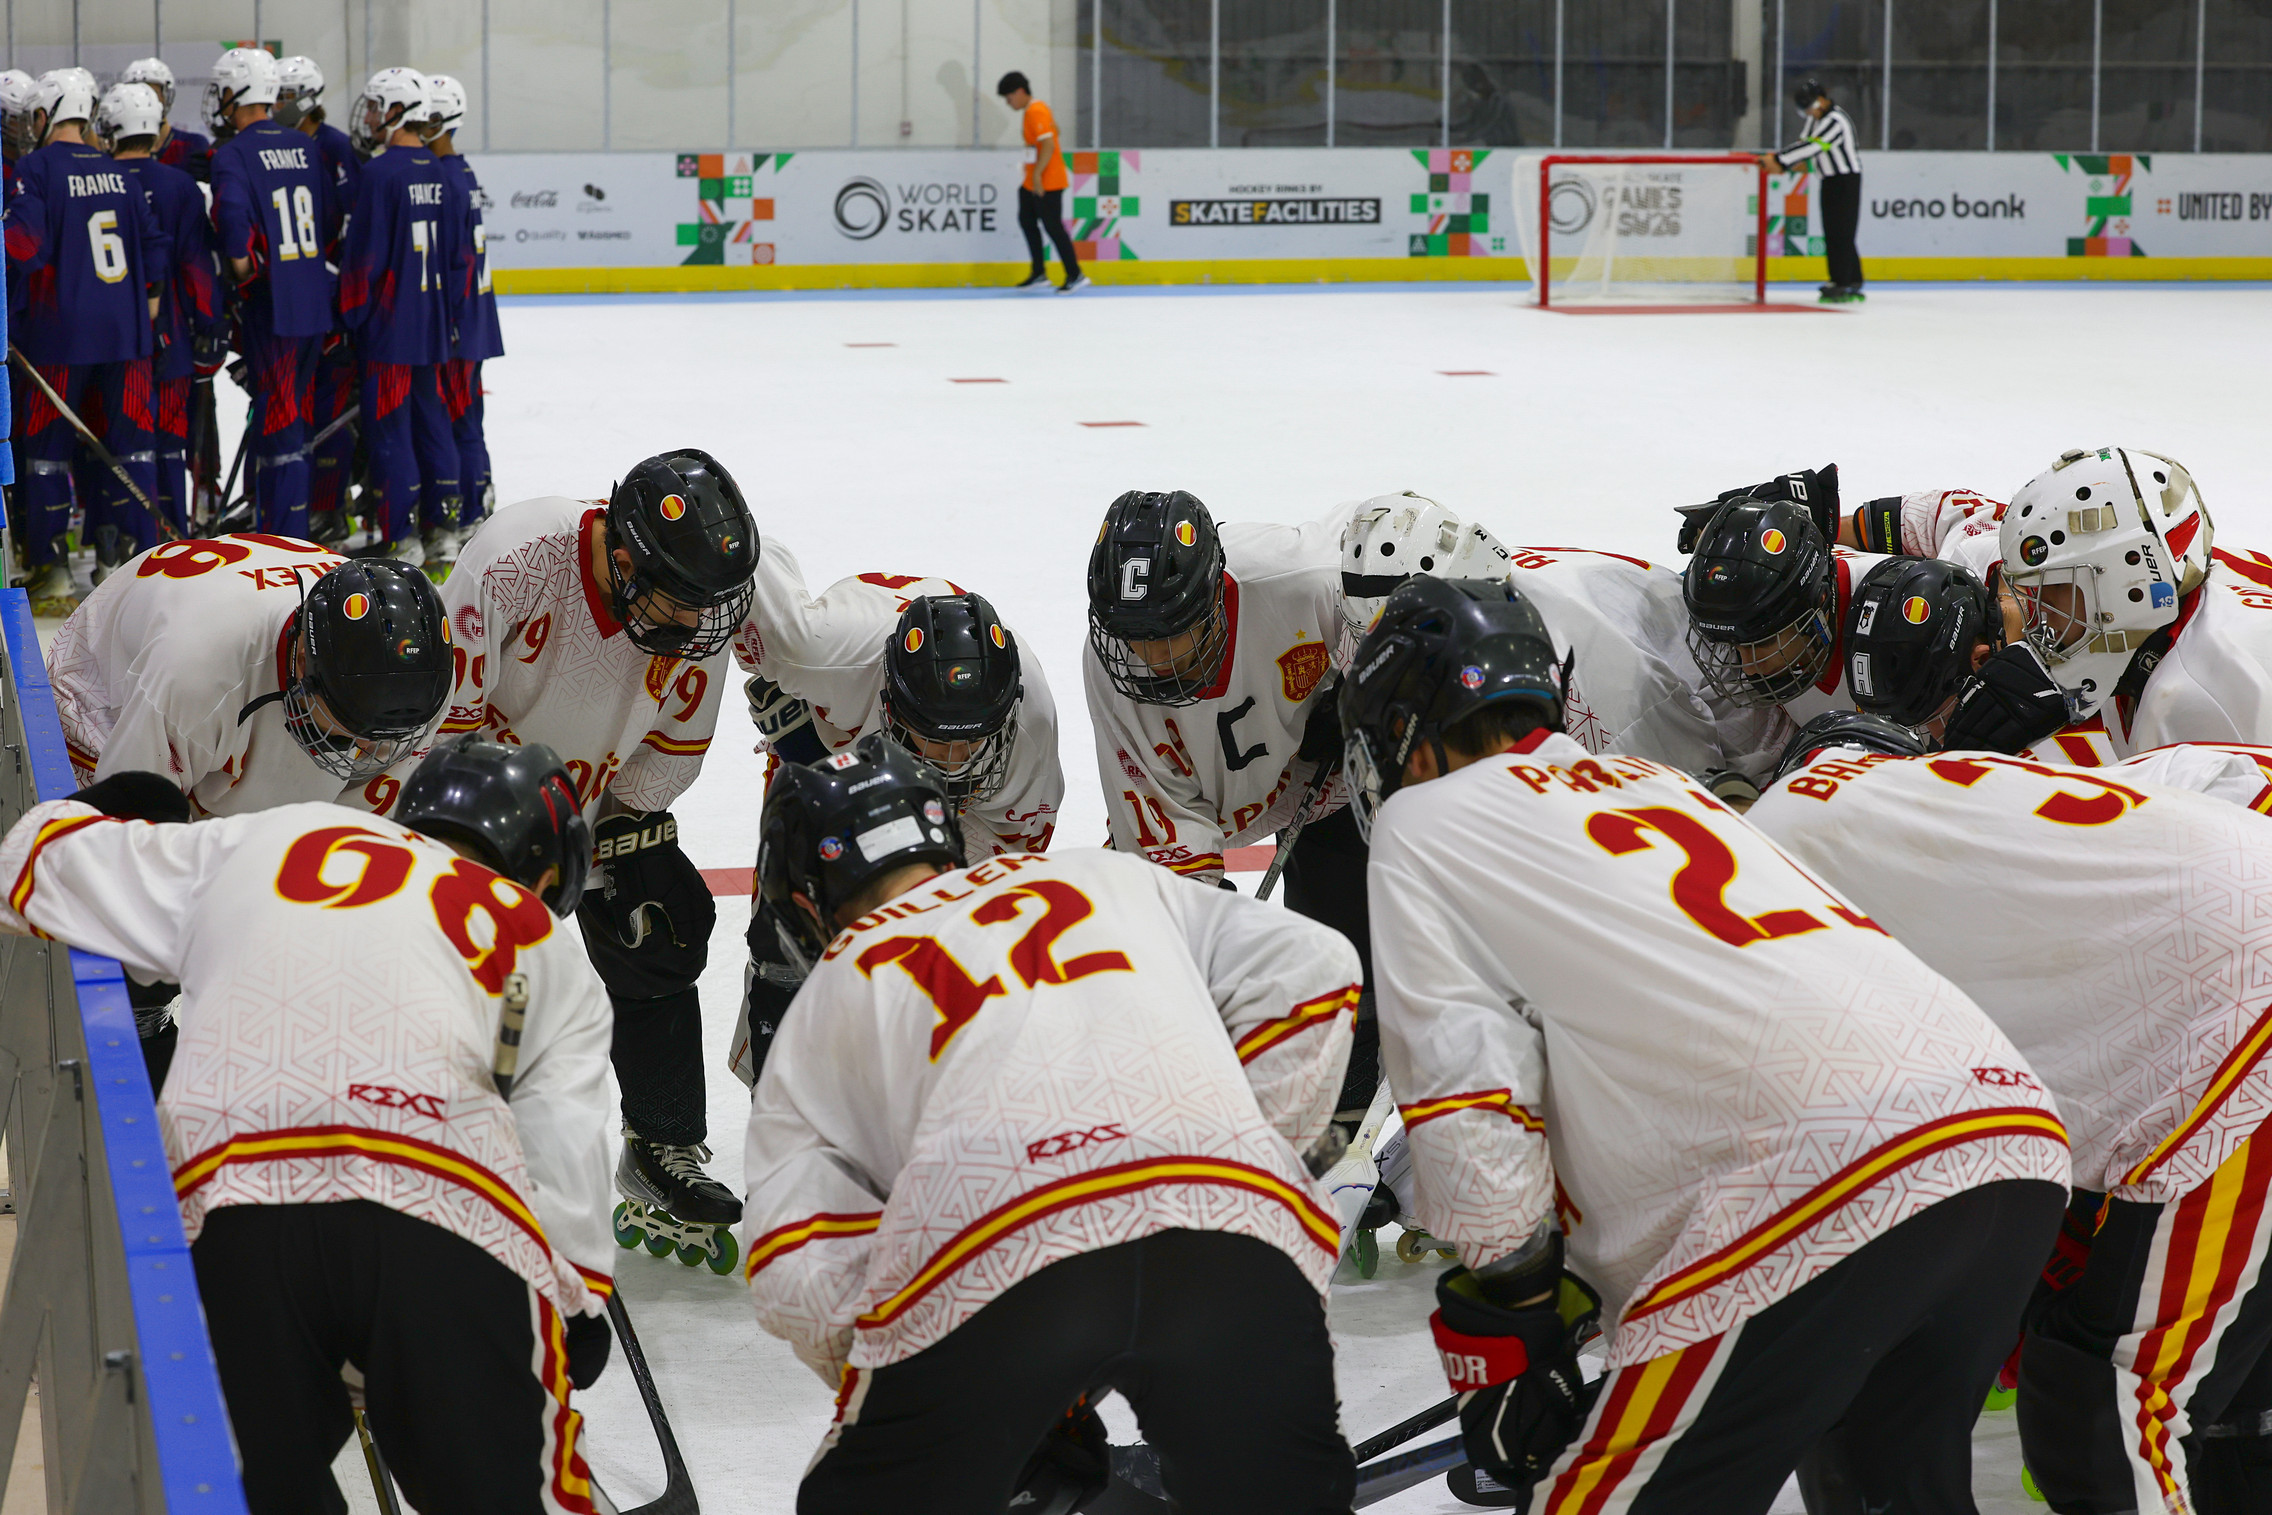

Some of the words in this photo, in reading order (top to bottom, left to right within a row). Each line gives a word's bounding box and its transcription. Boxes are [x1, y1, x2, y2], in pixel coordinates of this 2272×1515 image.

[258, 147, 309, 172] FRANCE
[67, 172, 127, 198] FRANCE
[898, 183, 998, 205] WORLD
[1229, 184, 1272, 194] HOCKEY
[1174, 200, 1377, 223] SKATEFACILITIES
[1871, 199, 1945, 219] ueno
[1952, 192, 2026, 219] bank
[2178, 192, 2243, 220] UNITED
[272, 185, 319, 262] 18
[897, 208, 997, 232] SKATE
[87, 210, 128, 284] 6
[628, 521, 651, 556] BAUER
[2030, 543, 2049, 557] RFEP
[1120, 557, 1151, 601] C
[1713, 573, 1728, 582] RFEP
[1800, 550, 1821, 587] BAUER
[308, 611, 318, 656] BAUER
[1698, 620, 1735, 633] BAUER
[1949, 605, 1965, 654] BAUER
[406, 646, 420, 655] RFEP
[956, 671, 972, 681] RFEP
[938, 722, 983, 731] BAUER
[1217, 696, 1269, 772] C
[847, 773, 893, 795] BAUER
[1122, 790, 1178, 848] 19
[820, 856, 1051, 963] GUILLEM
[855, 879, 1137, 1065] 12
[347, 1083, 445, 1122] REXS
[1026, 1123, 1129, 1165] REXS
[635, 1168, 665, 1199] BAUER
